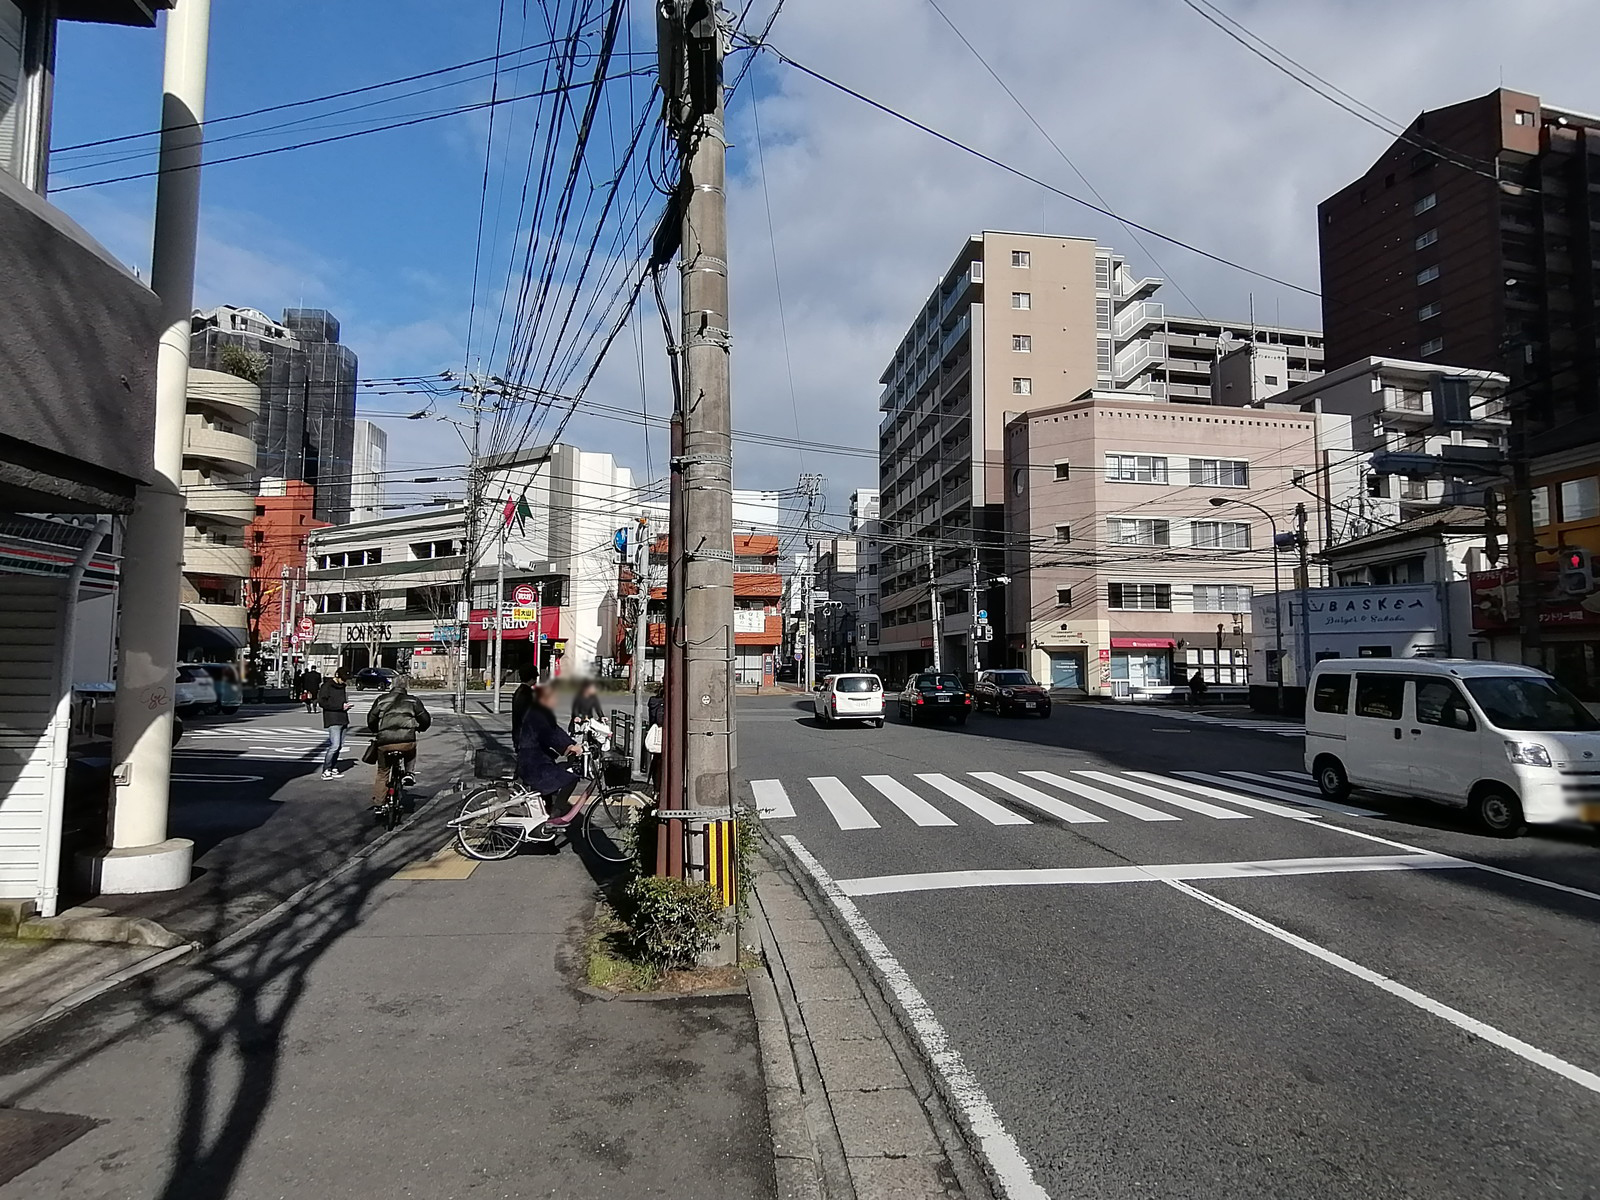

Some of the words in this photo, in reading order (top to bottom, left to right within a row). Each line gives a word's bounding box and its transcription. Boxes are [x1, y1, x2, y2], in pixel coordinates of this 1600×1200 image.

[1328, 597, 1424, 612] BASKET
[347, 625, 365, 641] BON
[367, 624, 392, 641] RAS
